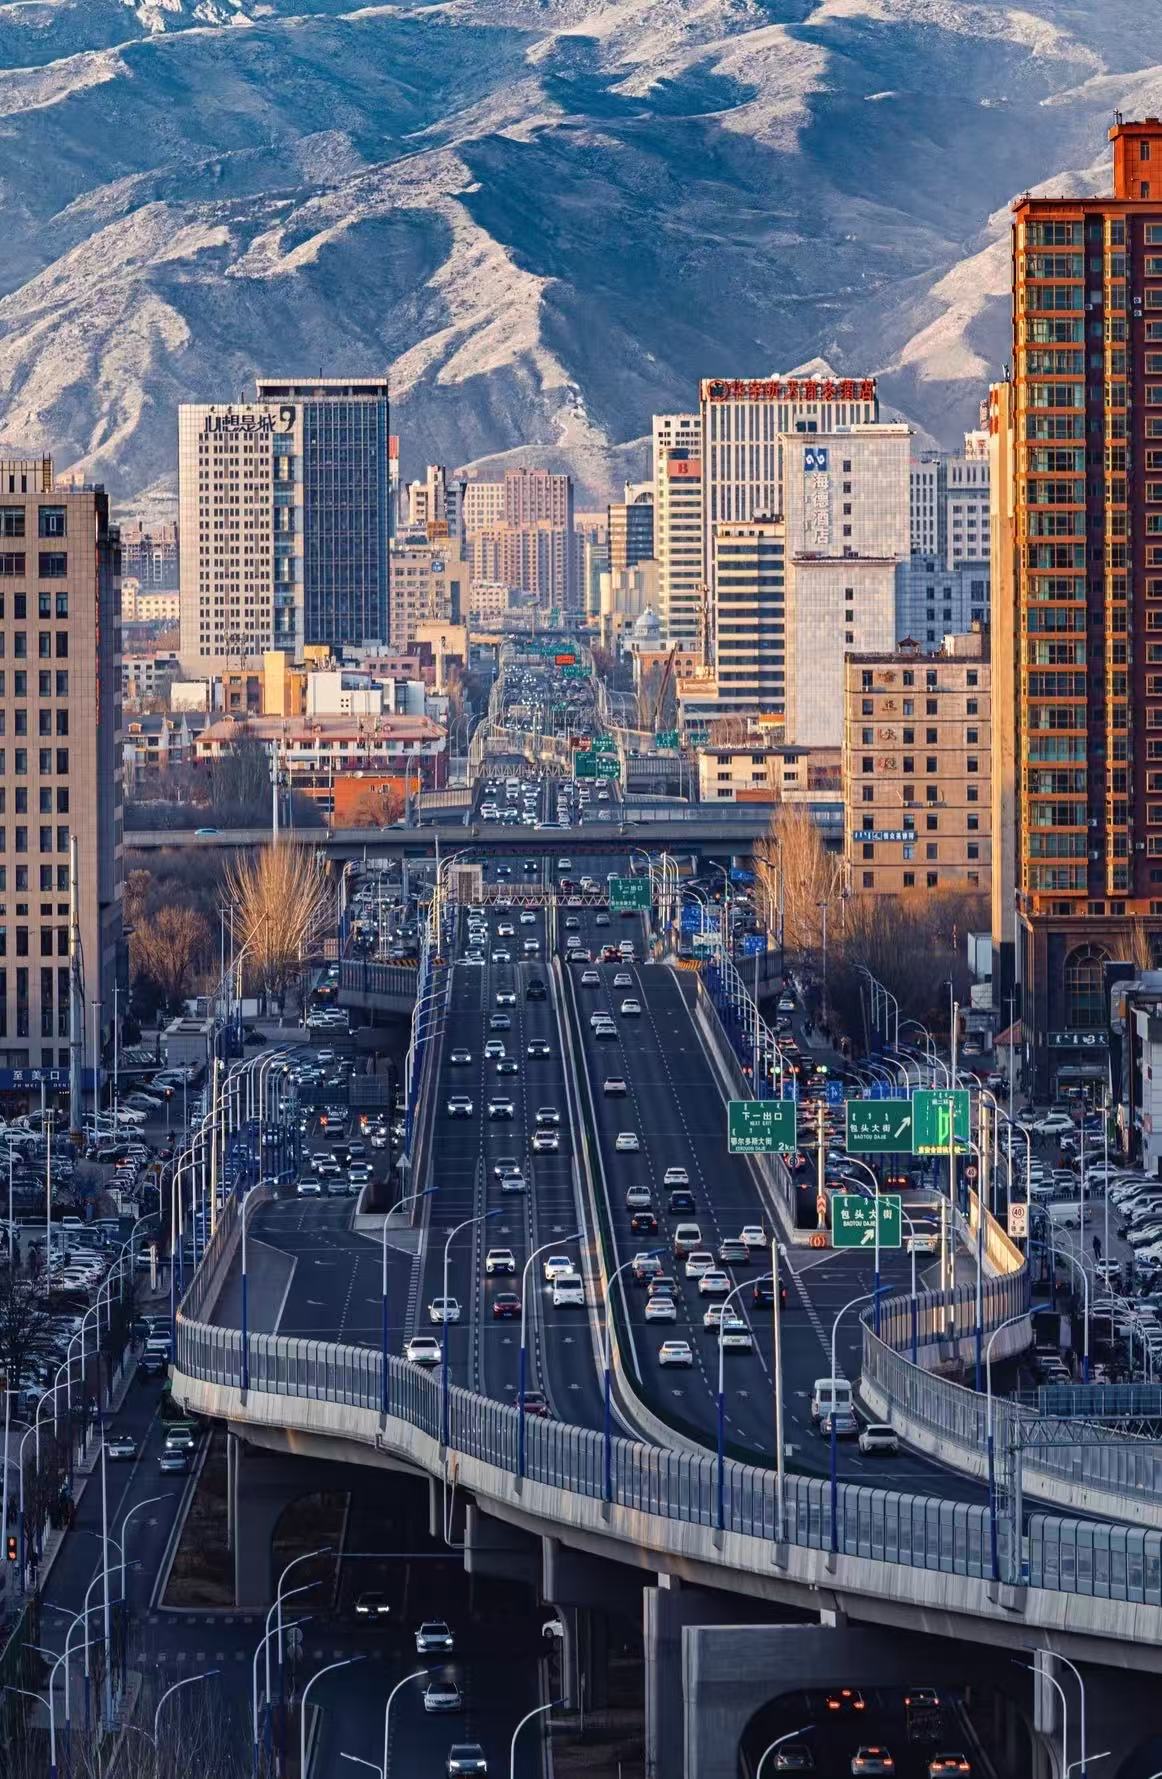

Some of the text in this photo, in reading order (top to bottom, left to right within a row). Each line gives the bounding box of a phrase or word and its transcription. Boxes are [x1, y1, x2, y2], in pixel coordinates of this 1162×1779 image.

[12, 1070, 72, 1081] 至美口
[741, 1111, 783, 1121] 下一出口
[849, 1123, 891, 1133] 包头大街
[730, 1137, 773, 1146] 鄂尔多斯大街
[840, 1209, 893, 1220] 包头大街
[1014, 1208, 1022, 1216] 40
